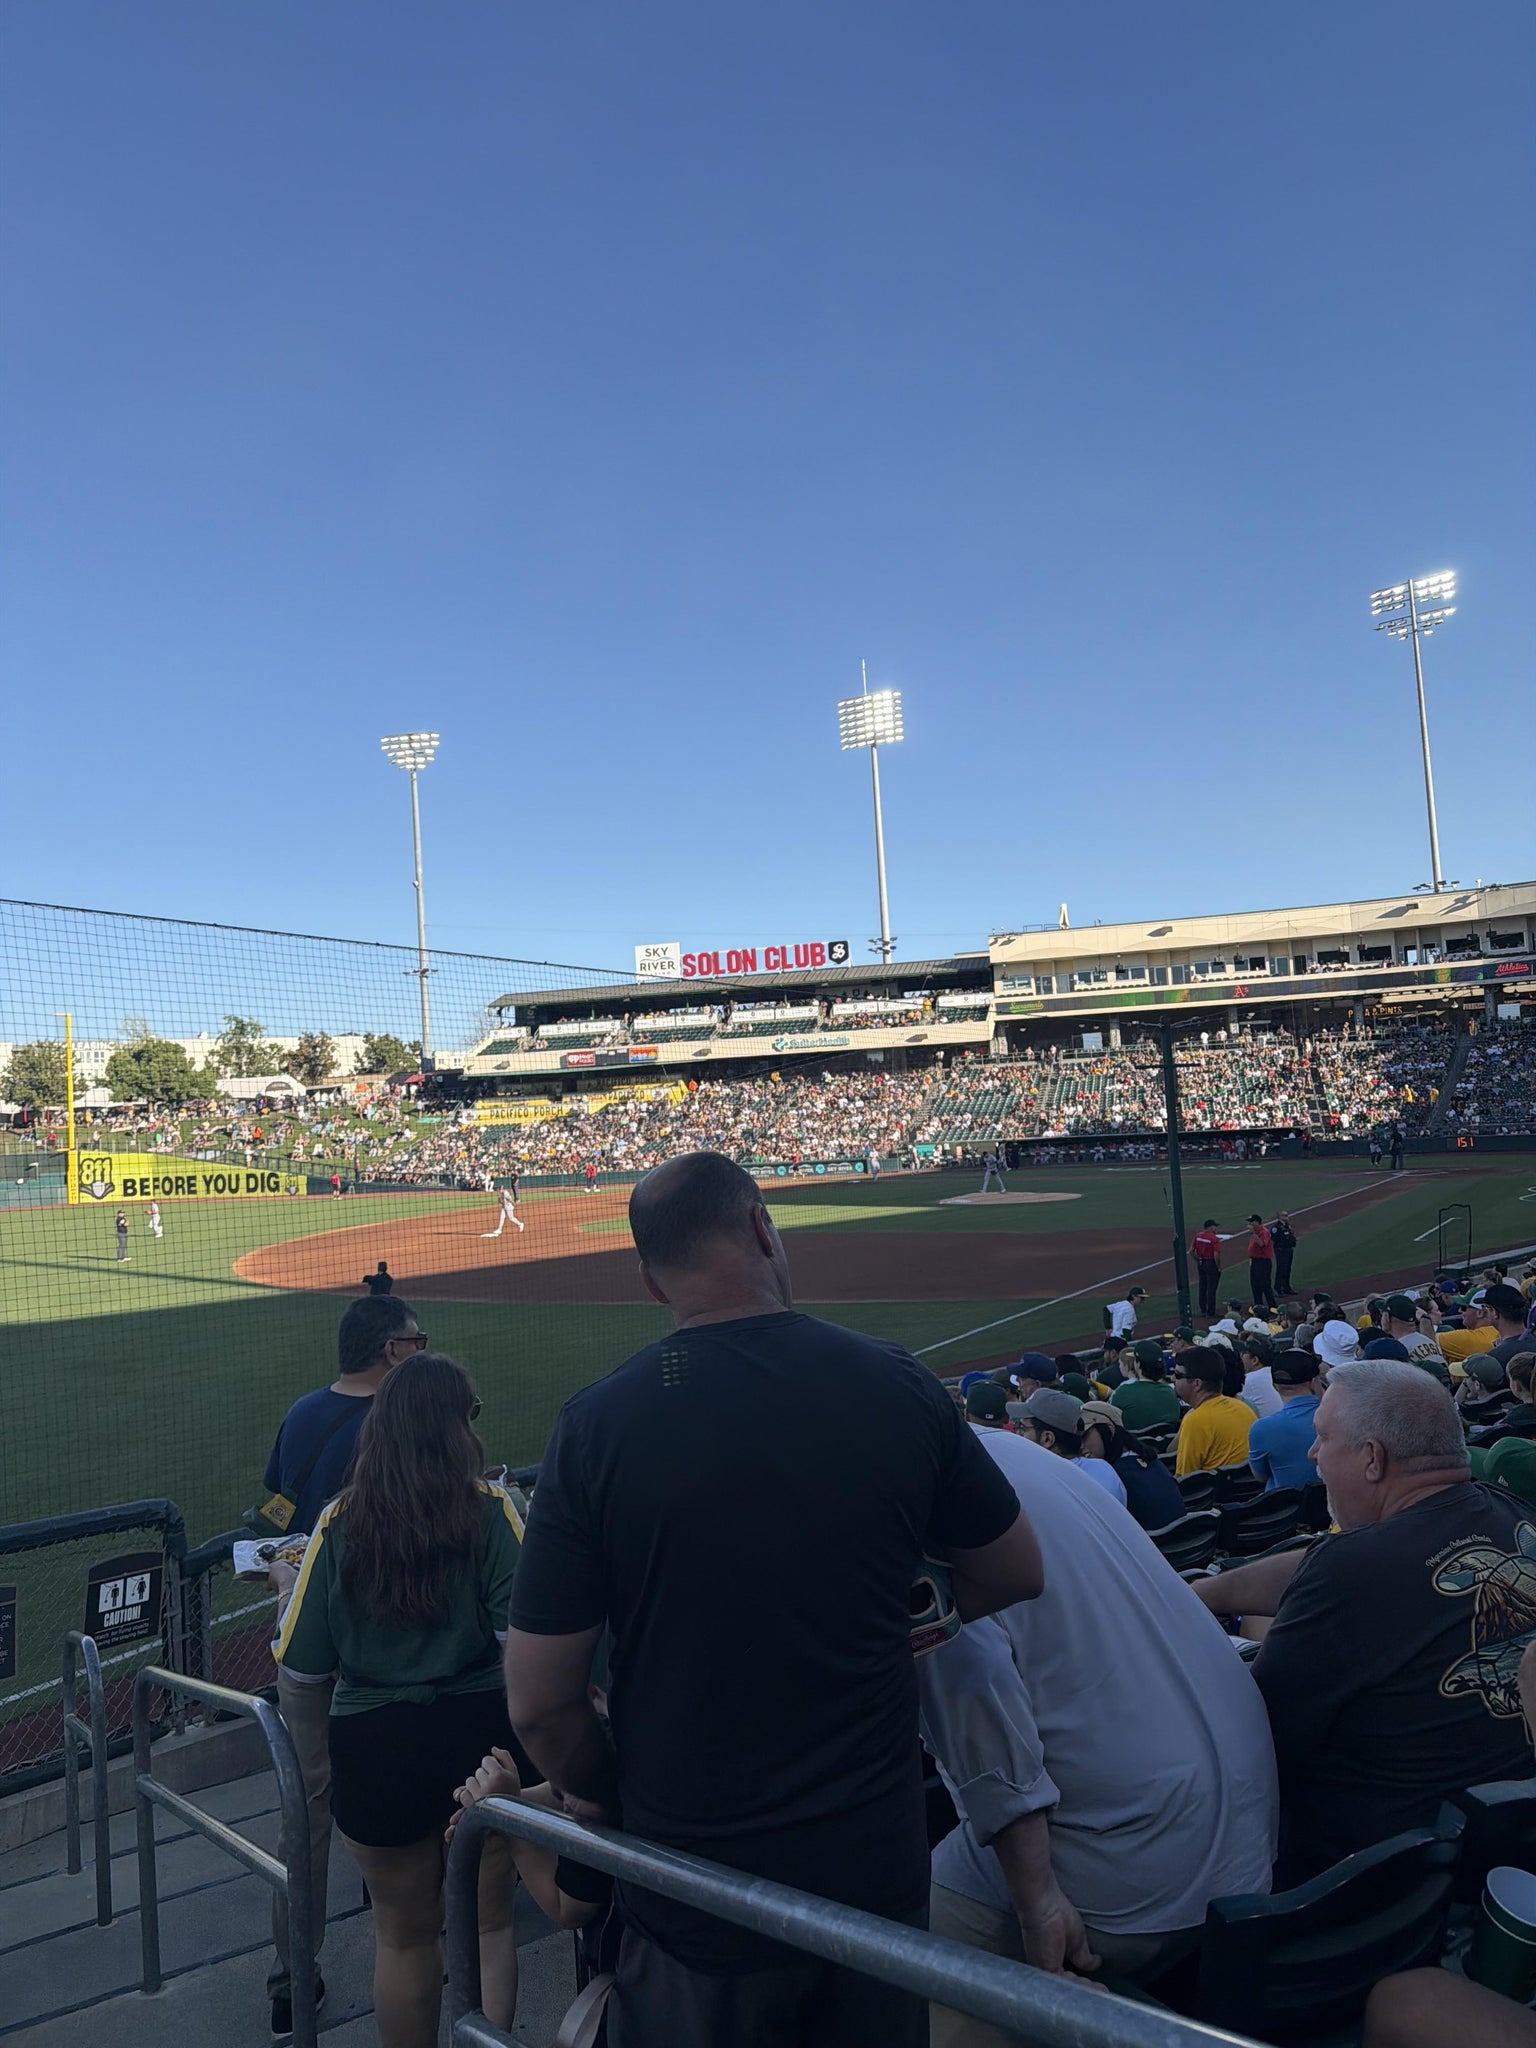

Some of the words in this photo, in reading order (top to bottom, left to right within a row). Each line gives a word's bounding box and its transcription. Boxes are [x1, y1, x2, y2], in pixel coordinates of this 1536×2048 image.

[645, 946, 668, 957] SKY
[682, 948, 757, 977] SOLON
[764, 942, 826, 971] CLUB
[640, 960, 675, 971] RIVER
[490, 1108, 529, 1119] PACIFICO
[534, 1106, 563, 1116] PORCH
[81, 1157, 112, 1185] 811
[122, 1176, 197, 1197] BEFORE
[202, 1173, 240, 1195] YOU
[246, 1172, 280, 1193] DIG
[104, 1604, 141, 1628] CAUTION!
